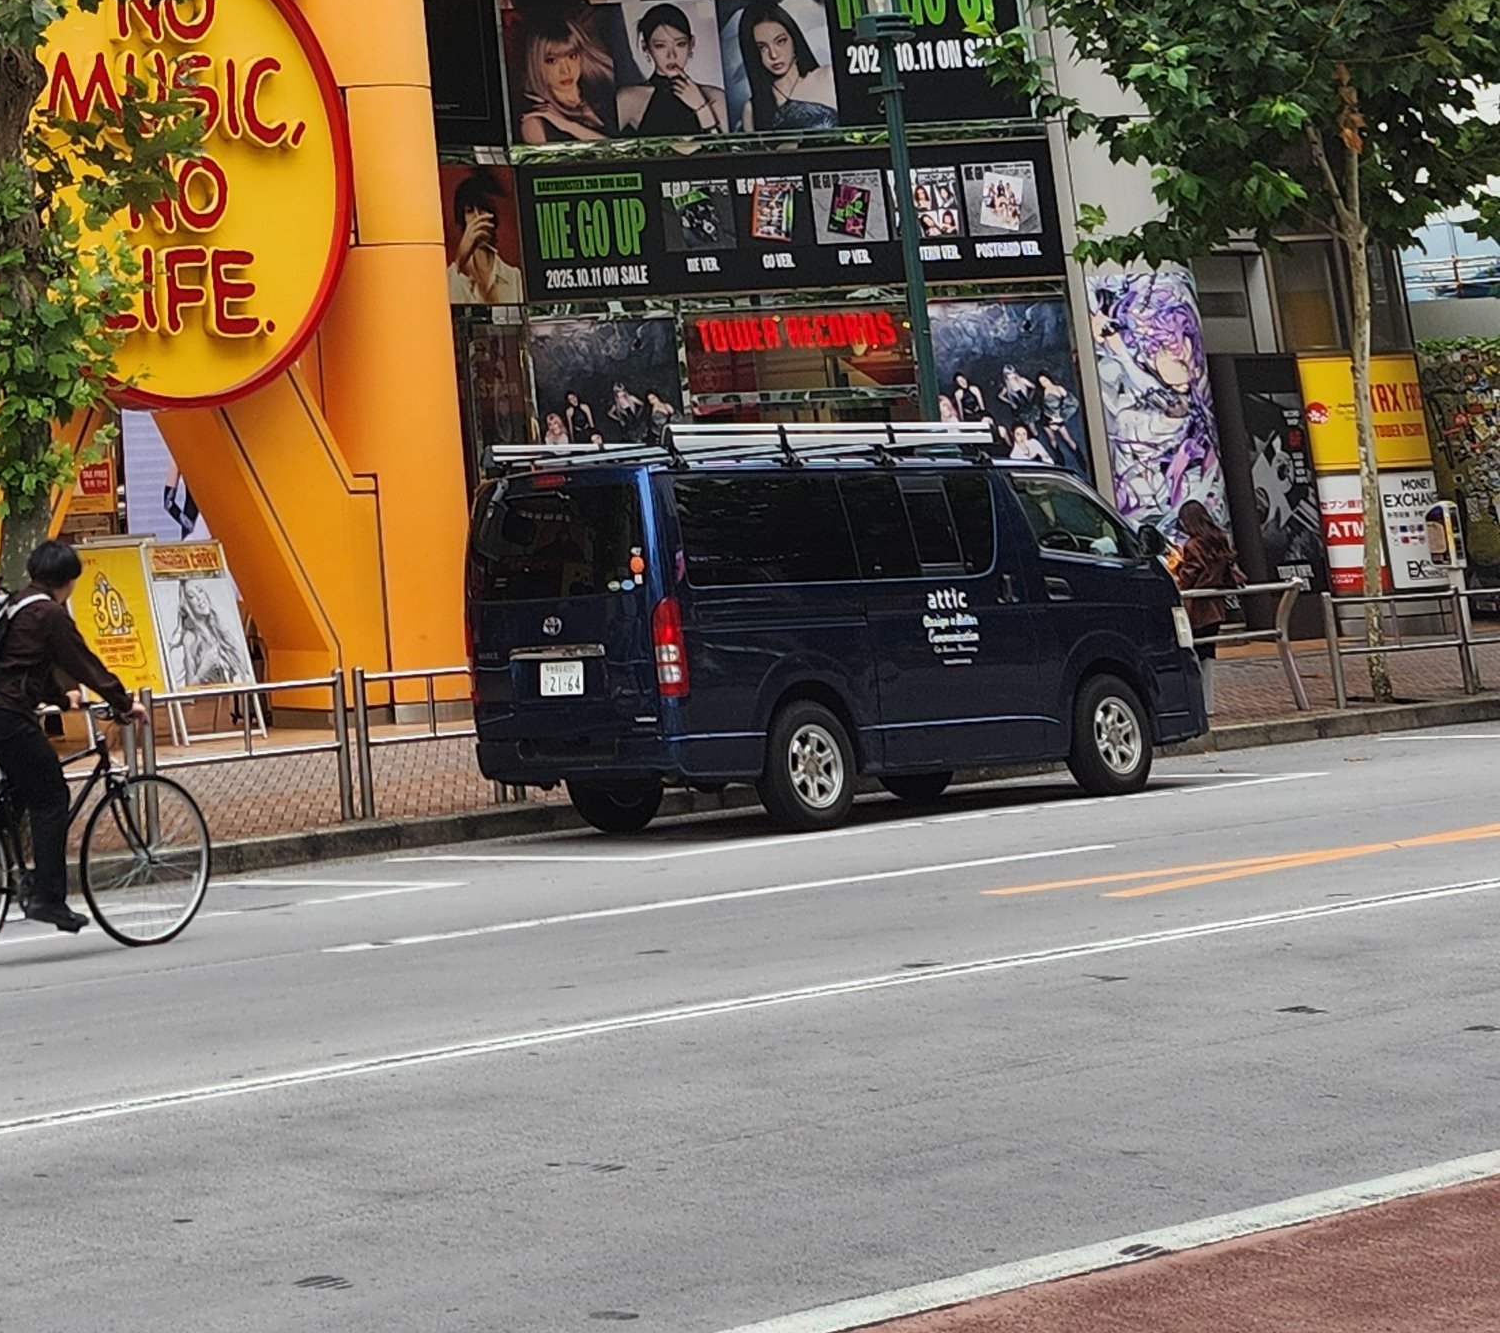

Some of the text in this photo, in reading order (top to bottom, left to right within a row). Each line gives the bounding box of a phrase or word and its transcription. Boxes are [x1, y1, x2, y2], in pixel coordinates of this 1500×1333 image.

[936, 38, 963, 69] ON
[535, 197, 647, 260] WE GO UP
[546, 264, 649, 289] 2025.10.11 ON SALE
[695, 312, 897, 353] TOWER RECORDS
[1370, 383, 1403, 414] TAX
[1401, 478, 1432, 490] MONEY
[926, 586, 968, 610] attic
